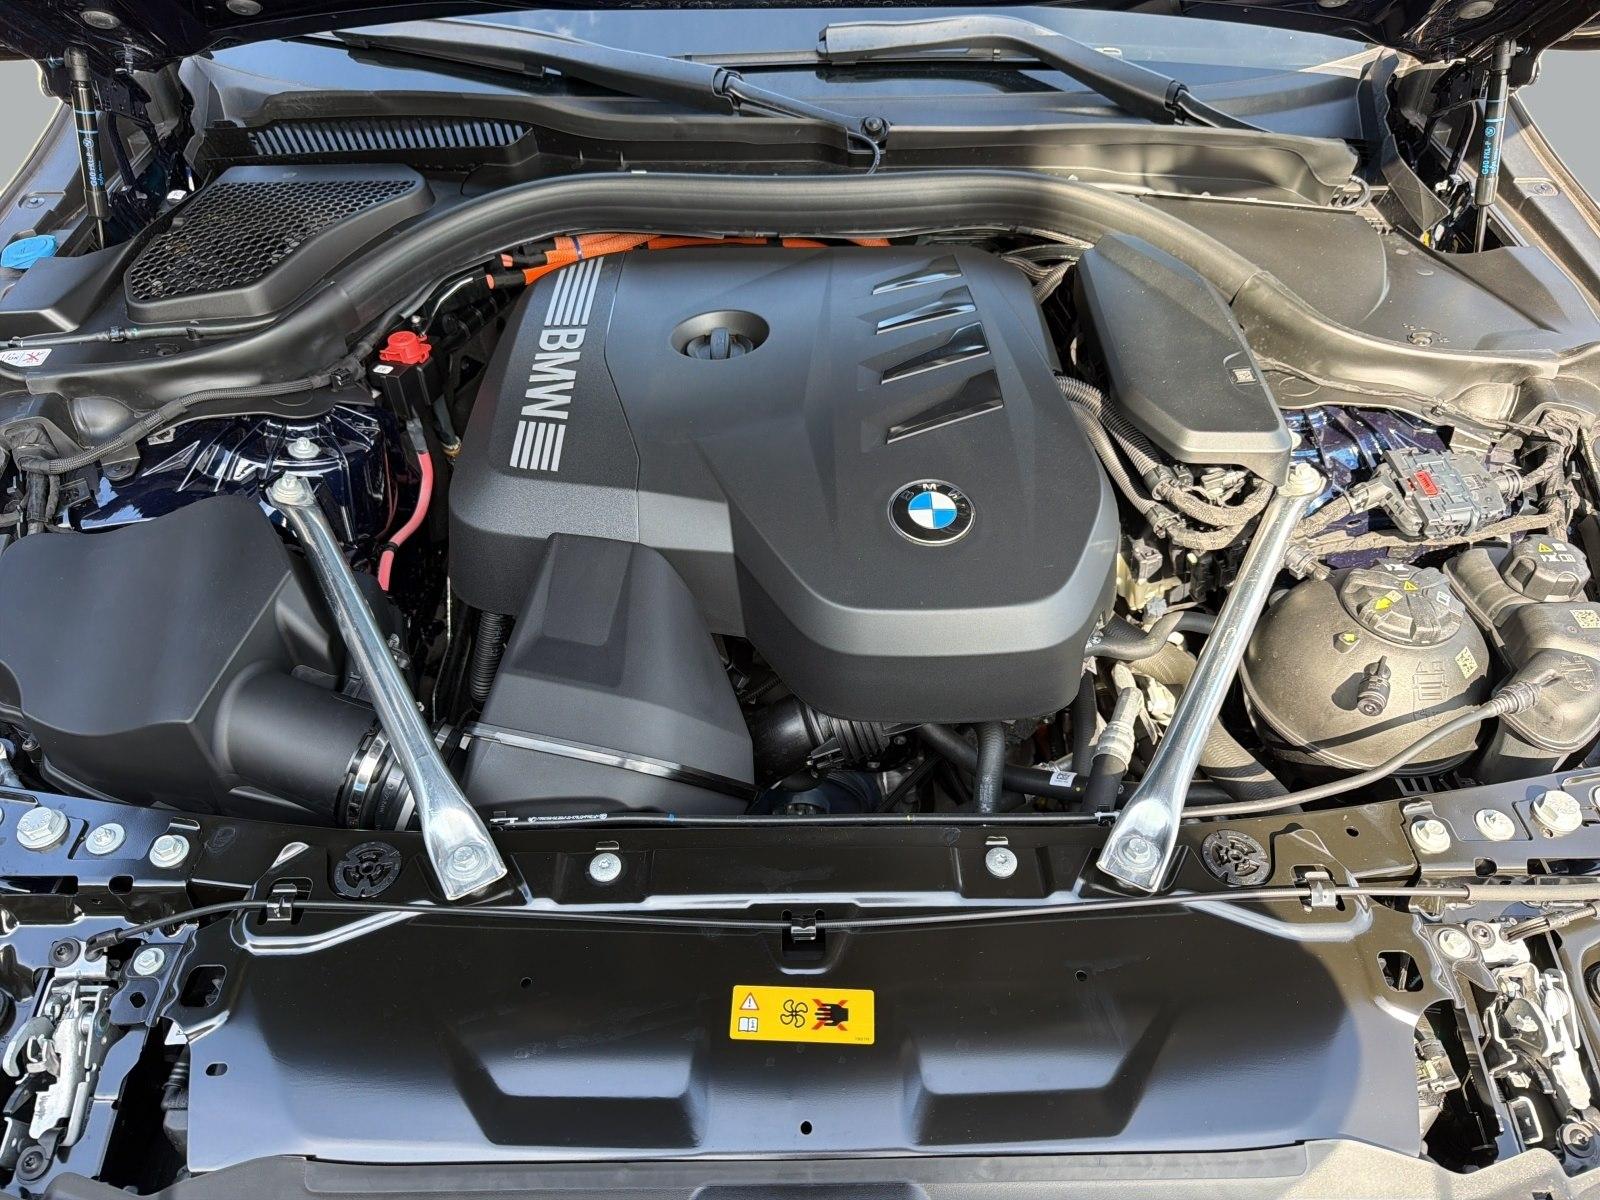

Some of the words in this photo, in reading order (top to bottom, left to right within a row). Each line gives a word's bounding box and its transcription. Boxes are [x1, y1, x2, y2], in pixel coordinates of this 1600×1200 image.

[1483, 140, 1492, 159] FKL-P
[1482, 160, 1490, 175] G60
[520, 328, 586, 420] BMW
